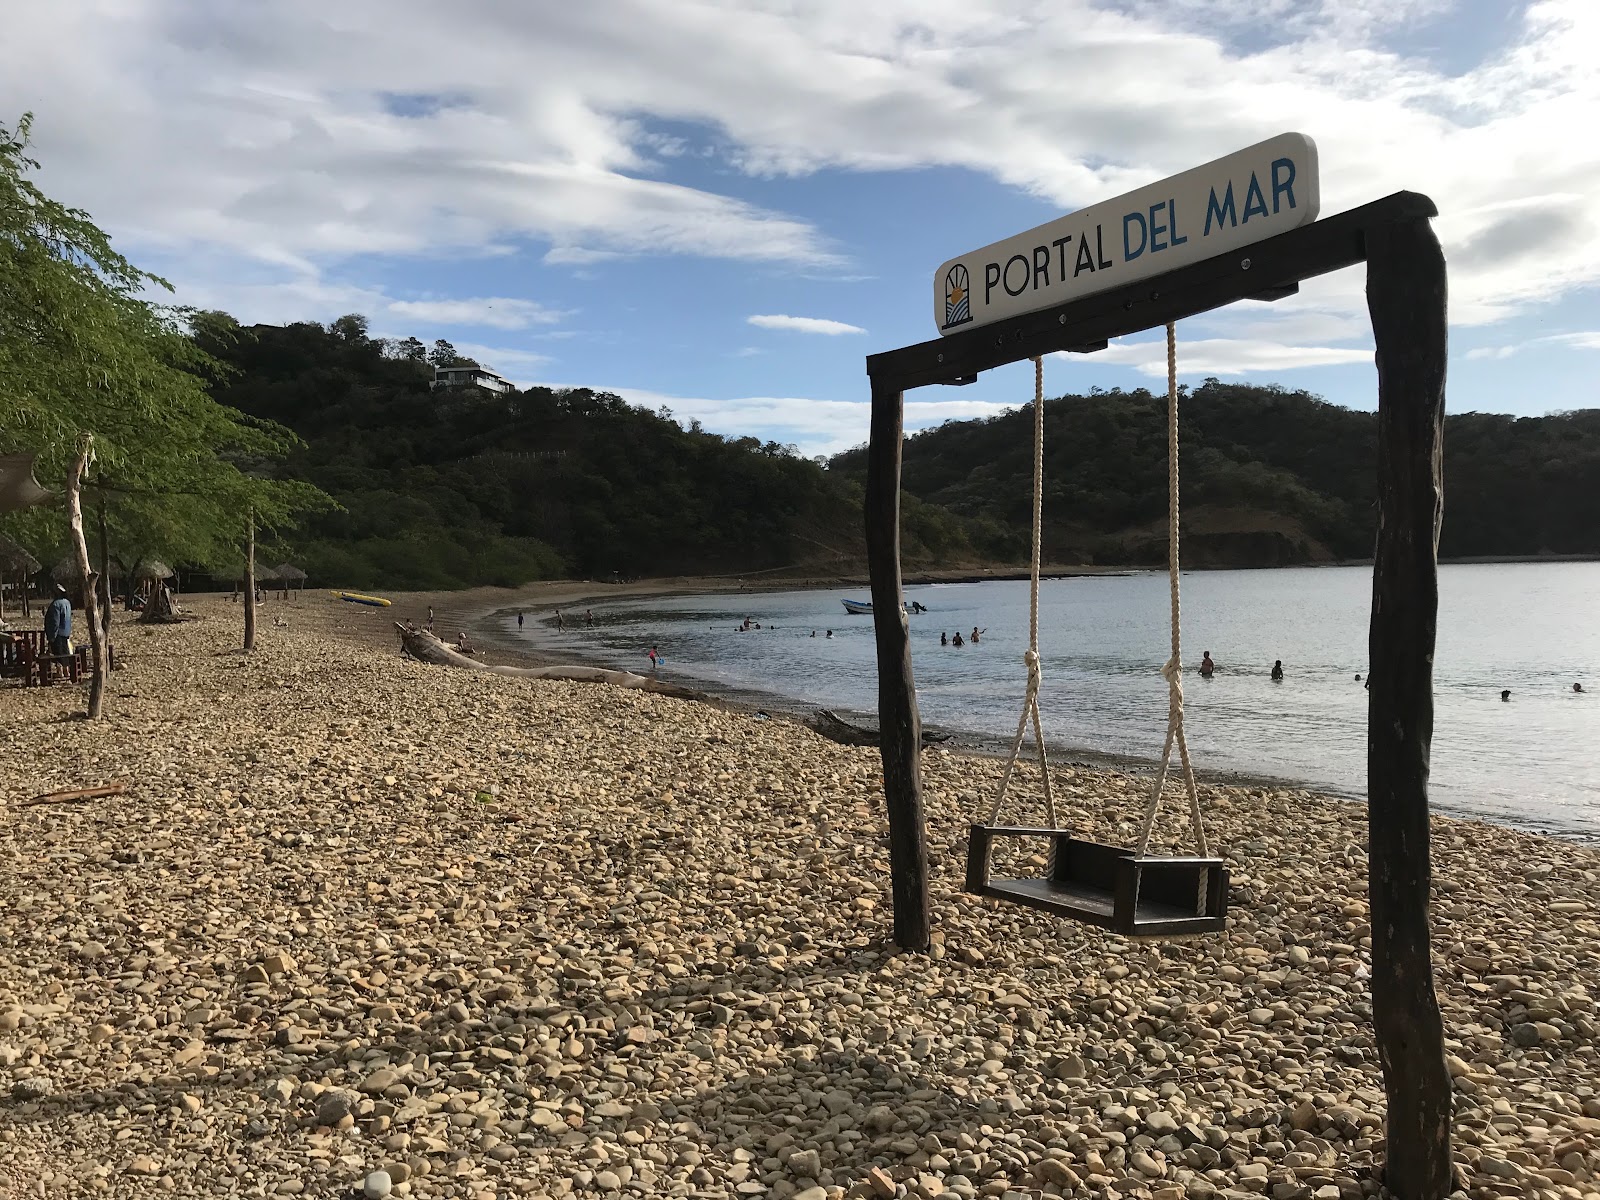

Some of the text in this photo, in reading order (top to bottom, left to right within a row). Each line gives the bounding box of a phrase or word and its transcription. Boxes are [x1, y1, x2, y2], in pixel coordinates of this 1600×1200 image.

[985, 157, 1296, 305] PORTAL DEL MAR
